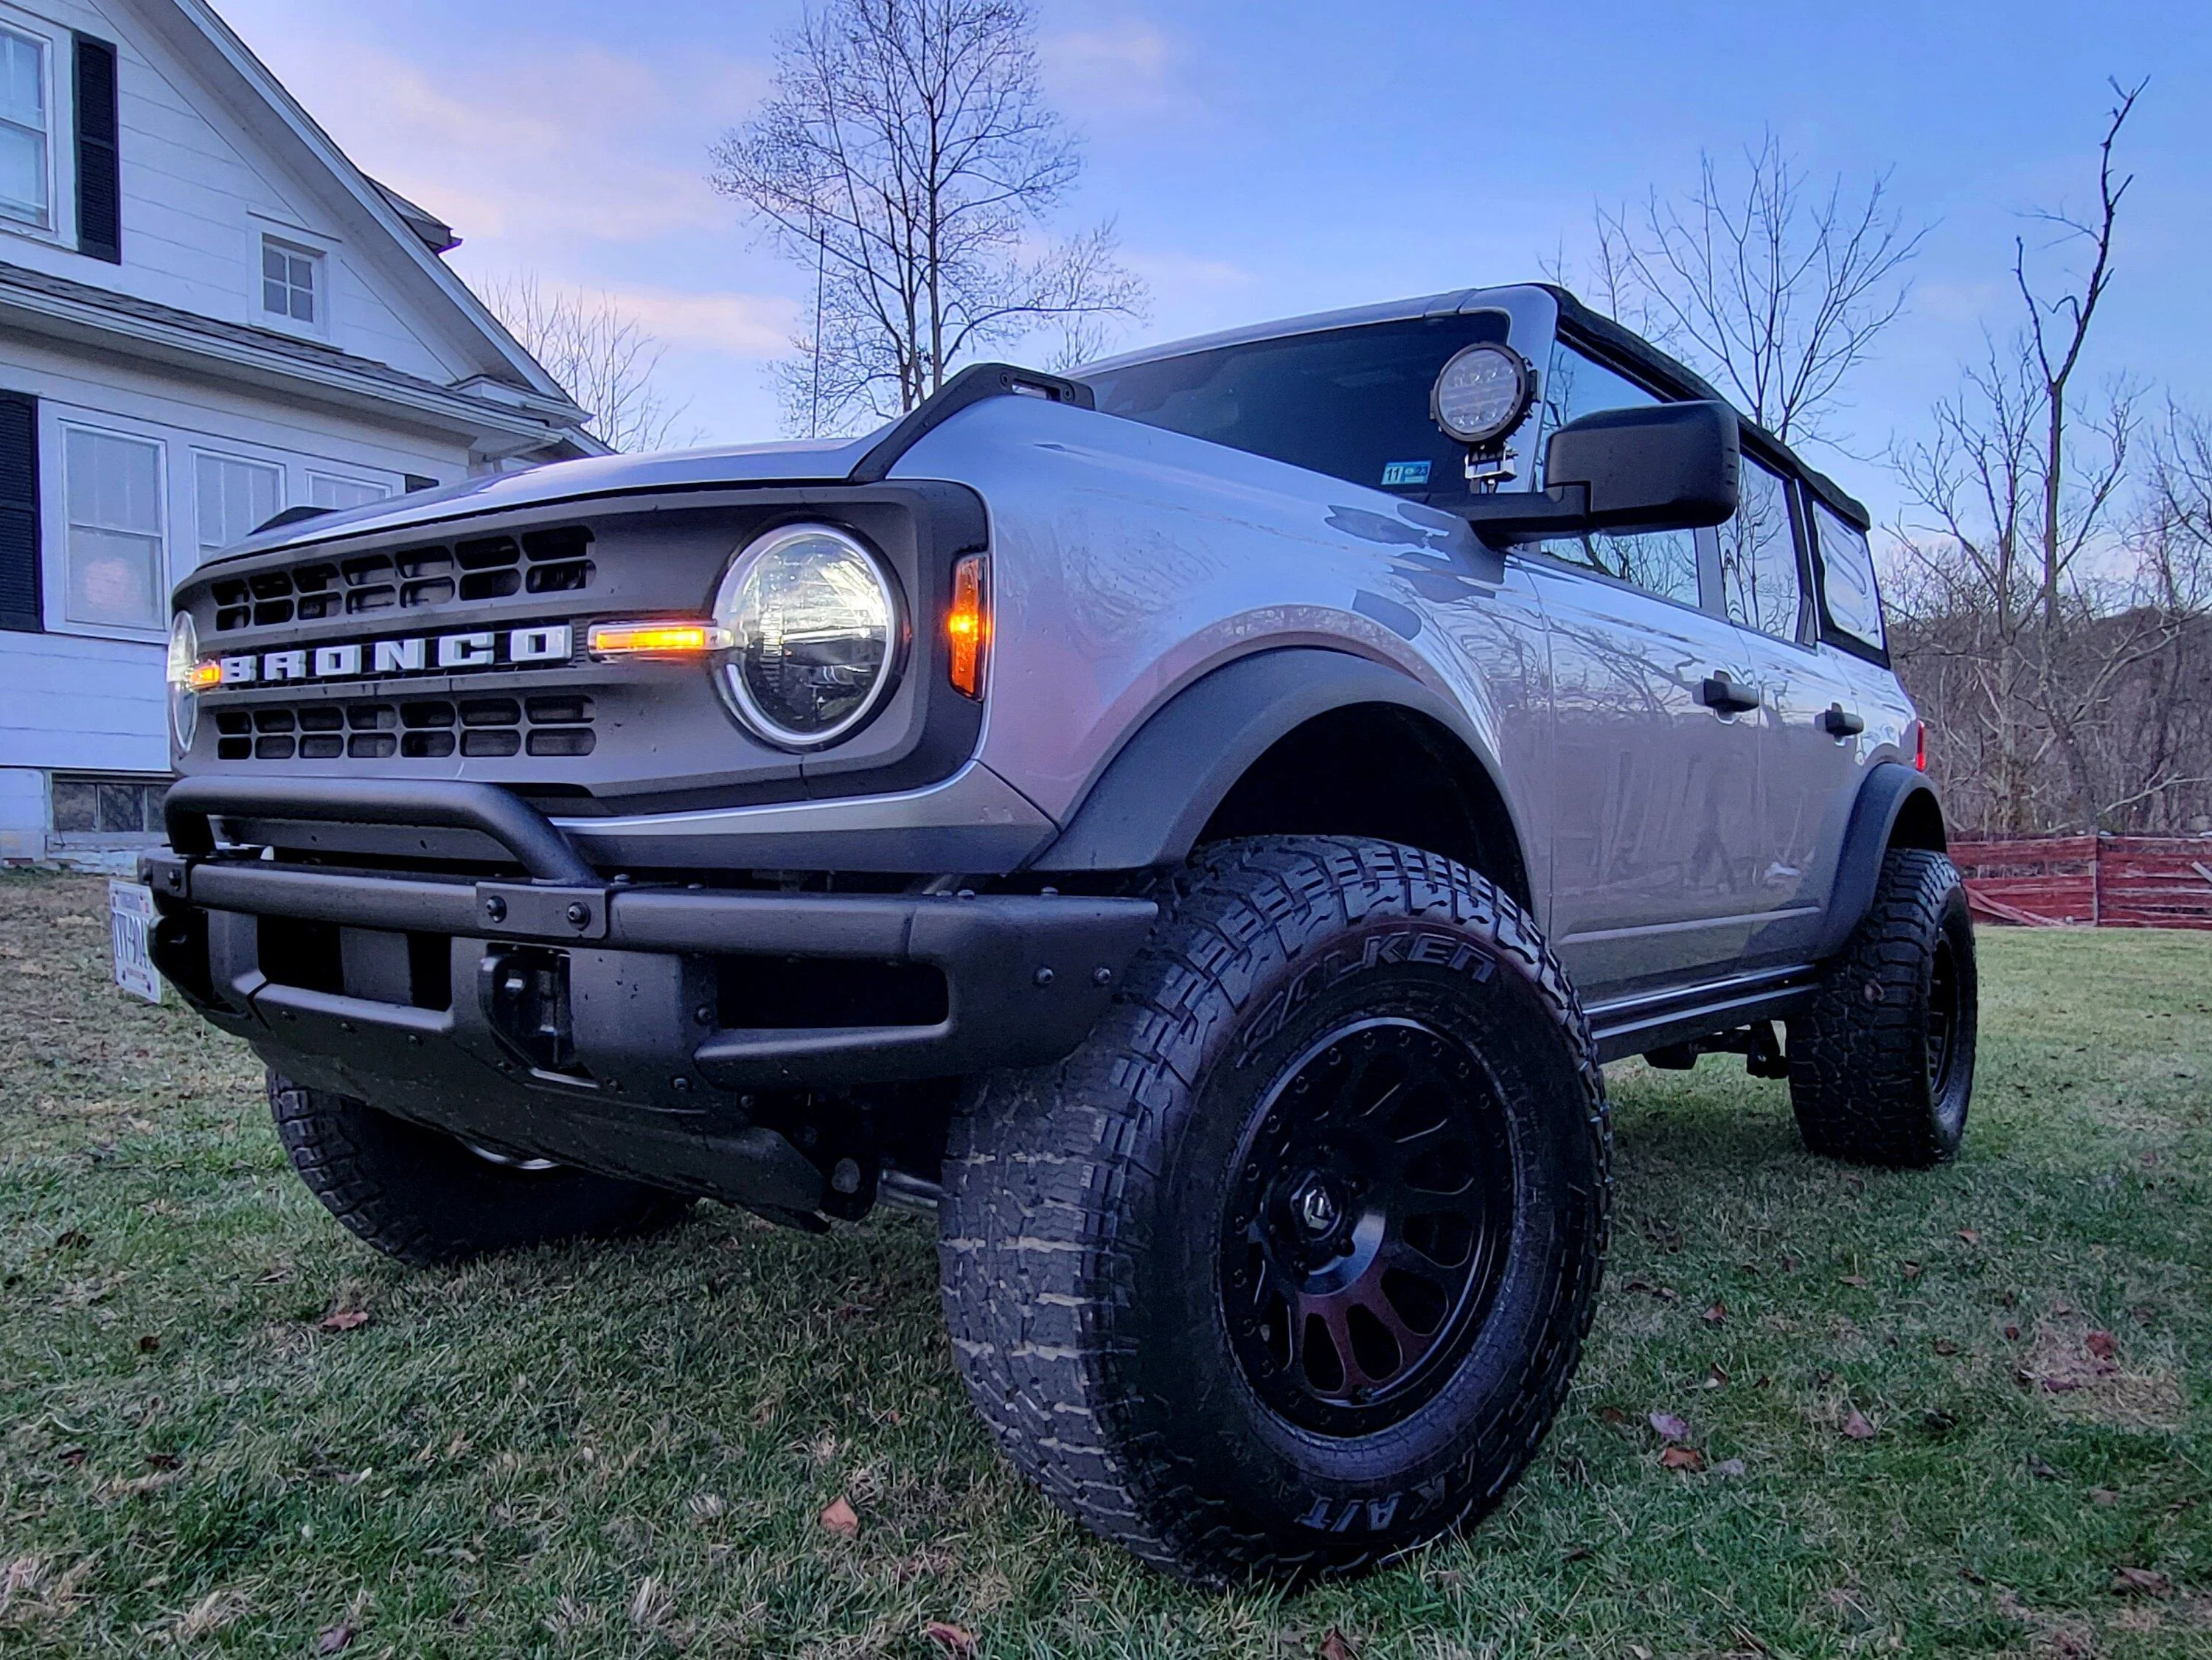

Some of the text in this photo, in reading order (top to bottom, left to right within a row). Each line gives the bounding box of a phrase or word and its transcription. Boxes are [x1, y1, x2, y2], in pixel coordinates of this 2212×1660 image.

[1386, 467, 1400, 482] 11
[220, 624, 574, 684] BRONCO
[1293, 1490, 1405, 1532] A/T
